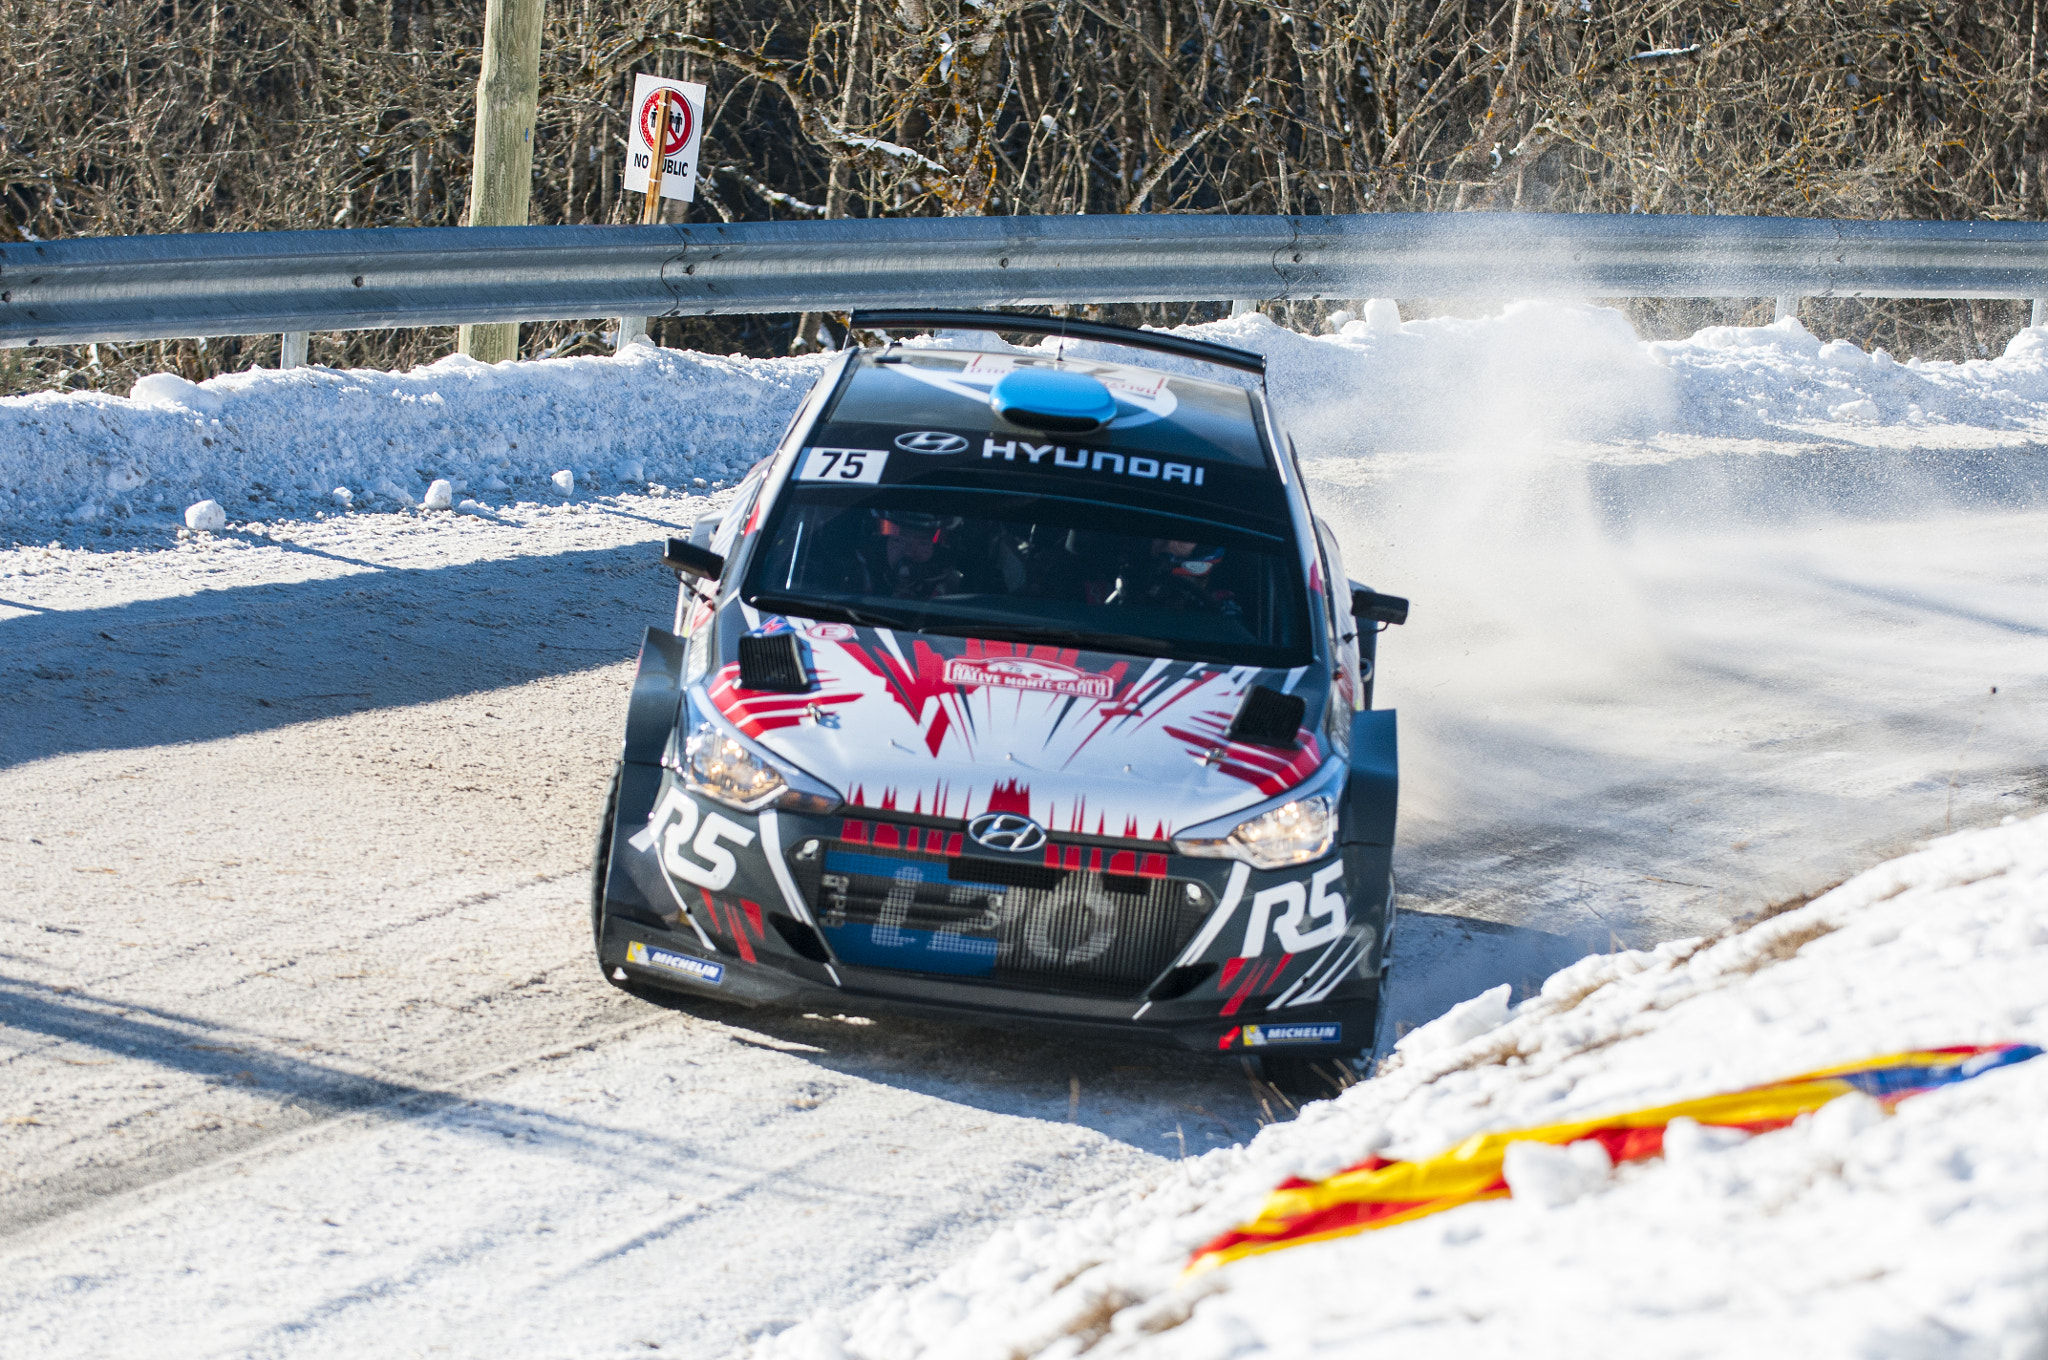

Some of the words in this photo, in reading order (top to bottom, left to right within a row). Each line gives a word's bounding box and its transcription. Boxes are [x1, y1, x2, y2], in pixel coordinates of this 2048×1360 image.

[634, 153, 649, 169] NO
[662, 158, 689, 177] UBLIC
[816, 451, 867, 479] 75
[982, 438, 1205, 486] HYUNDAI
[822, 626, 839, 637] E
[953, 666, 1000, 684] RALLYE
[1004, 675, 1053, 690] MONTE
[628, 786, 756, 892] R5
[1240, 858, 1347, 959] R5
[652, 951, 720, 978] MICHELIN
[1267, 1026, 1337, 1039] MICHELIN
